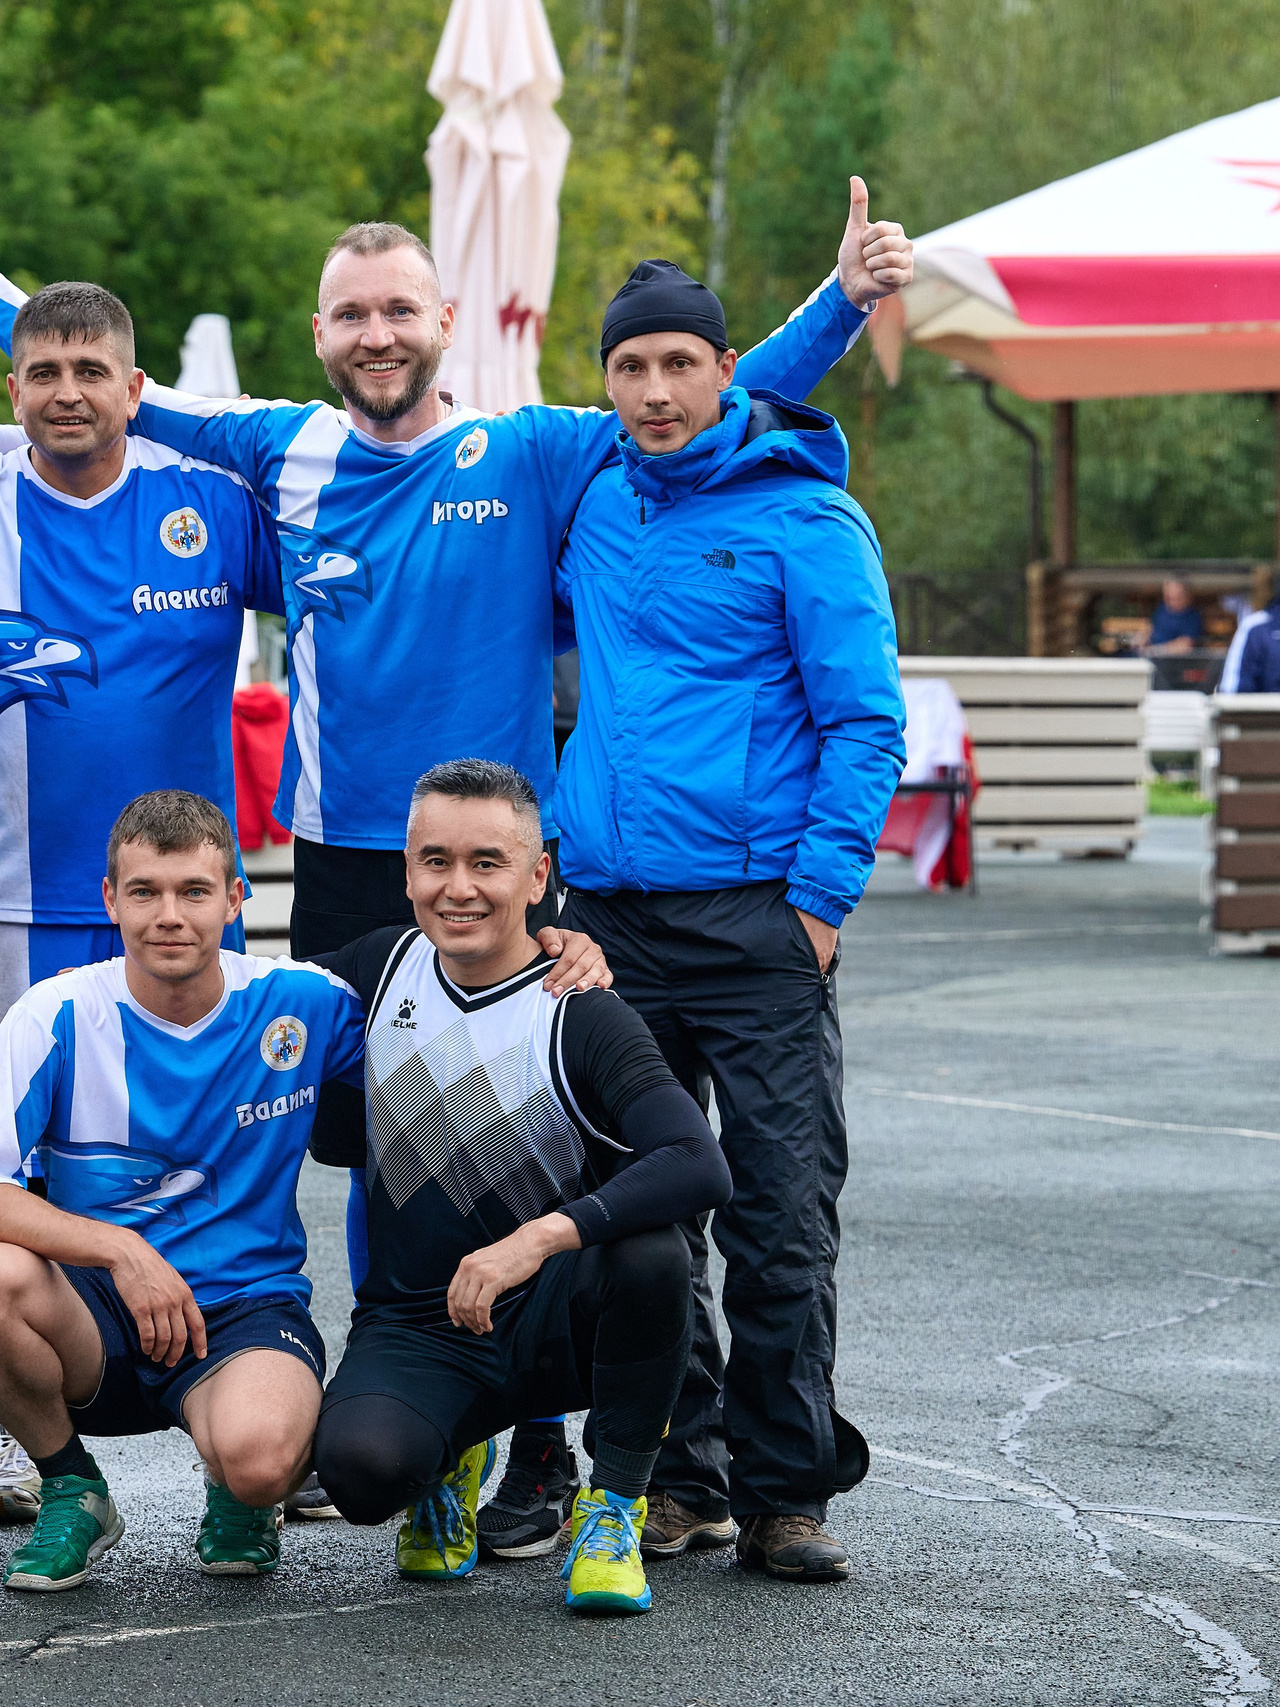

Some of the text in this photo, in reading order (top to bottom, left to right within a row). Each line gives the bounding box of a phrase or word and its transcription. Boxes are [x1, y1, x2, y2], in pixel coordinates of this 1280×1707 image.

[431, 498, 509, 526] Игорь
[701, 553, 725, 561] NORTH
[706, 559, 723, 568] FACE
[131, 580, 230, 616] Алексей
[235, 1085, 315, 1129] Вадим
